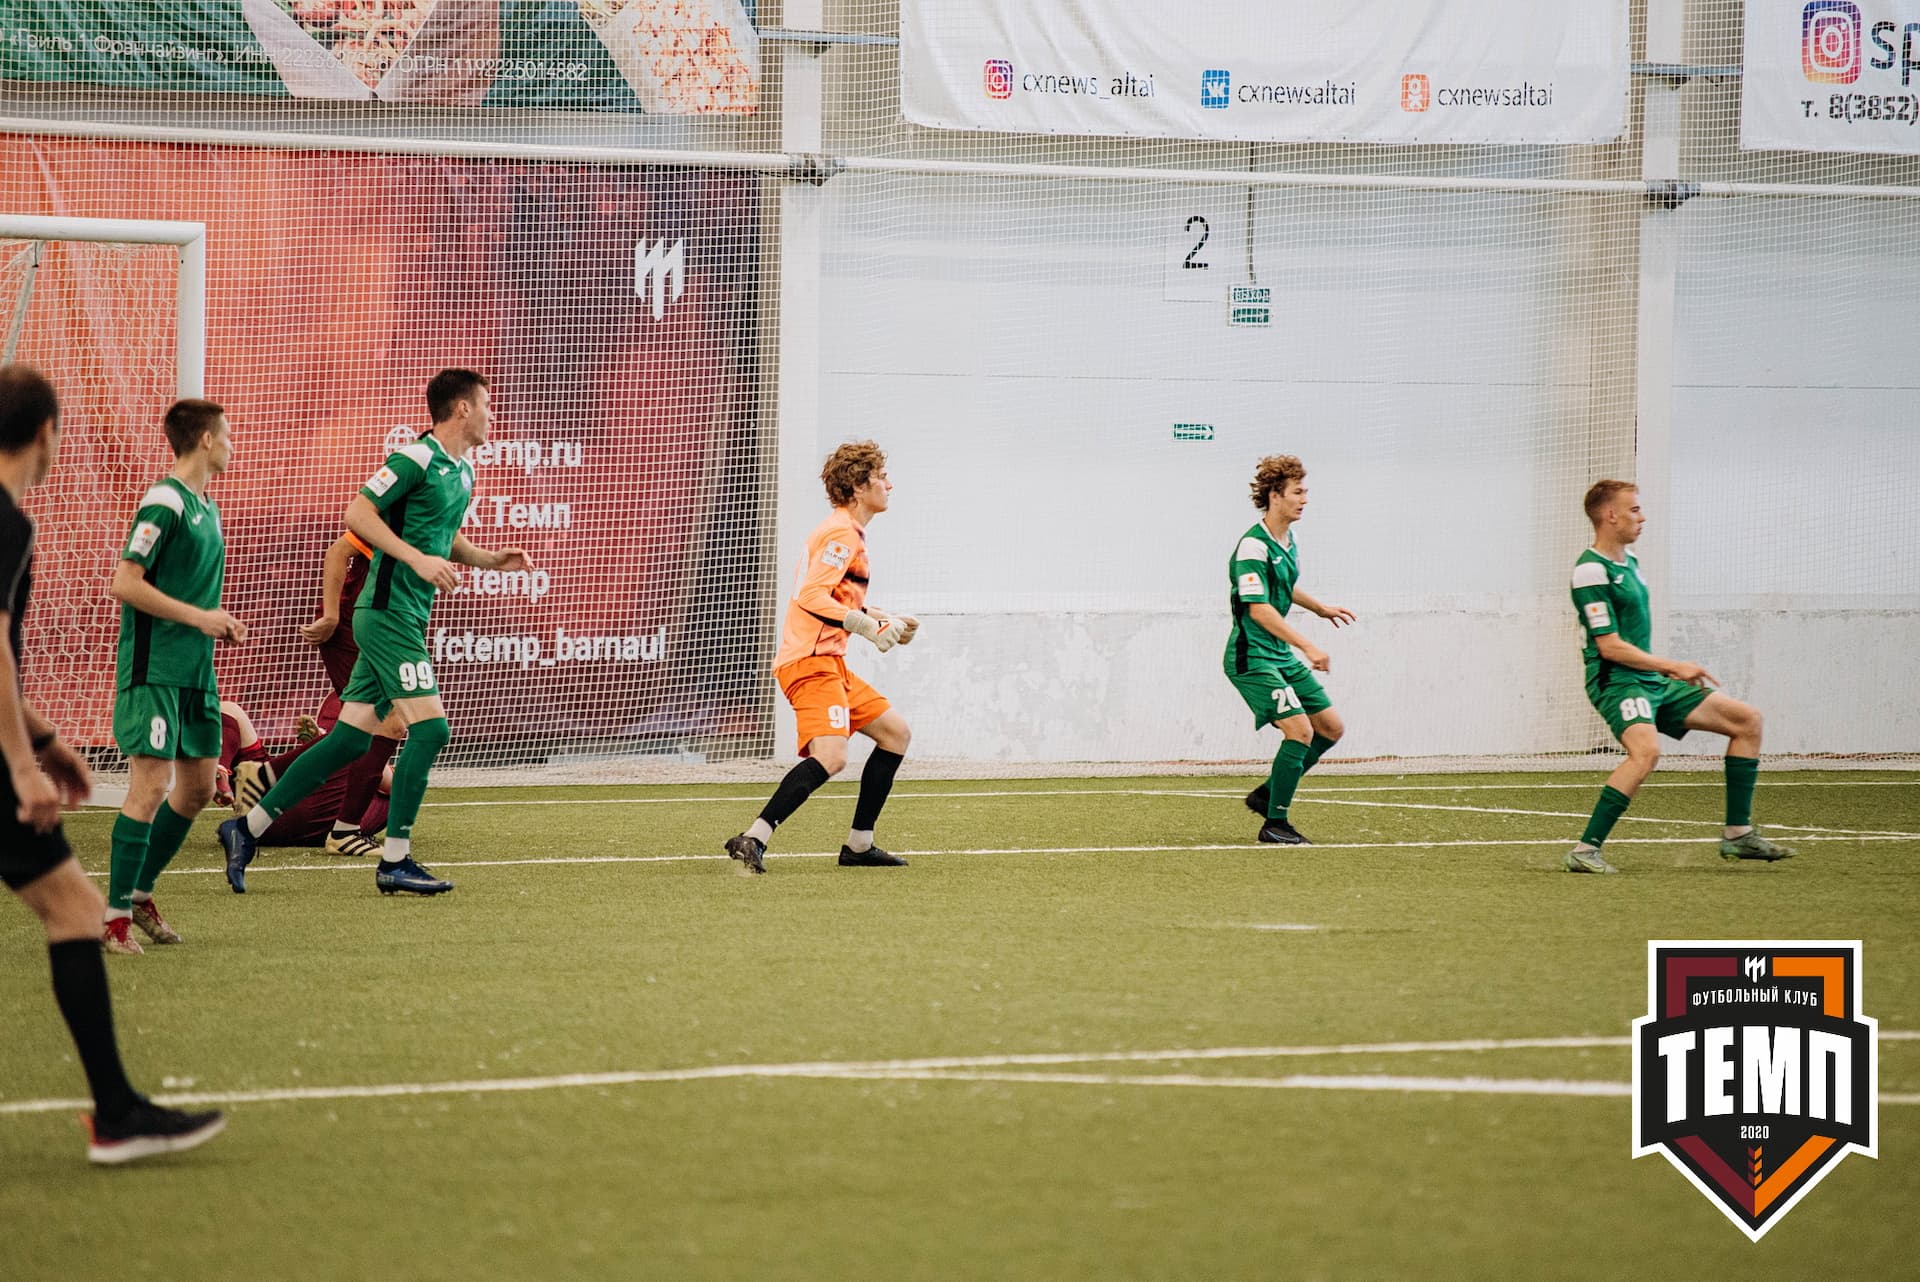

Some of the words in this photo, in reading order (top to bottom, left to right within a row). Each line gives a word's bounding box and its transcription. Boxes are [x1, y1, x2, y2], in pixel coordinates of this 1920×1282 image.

[1238, 79, 1357, 106] cxnewsaltai
[1437, 81, 1554, 107] cxnewsaltai
[1183, 215, 1209, 269] 2
[489, 495, 570, 529] Темп
[434, 627, 667, 670] fctemp_barnaul
[399, 660, 434, 691] 99
[1619, 697, 1653, 721] 80
[150, 715, 167, 750] 8
